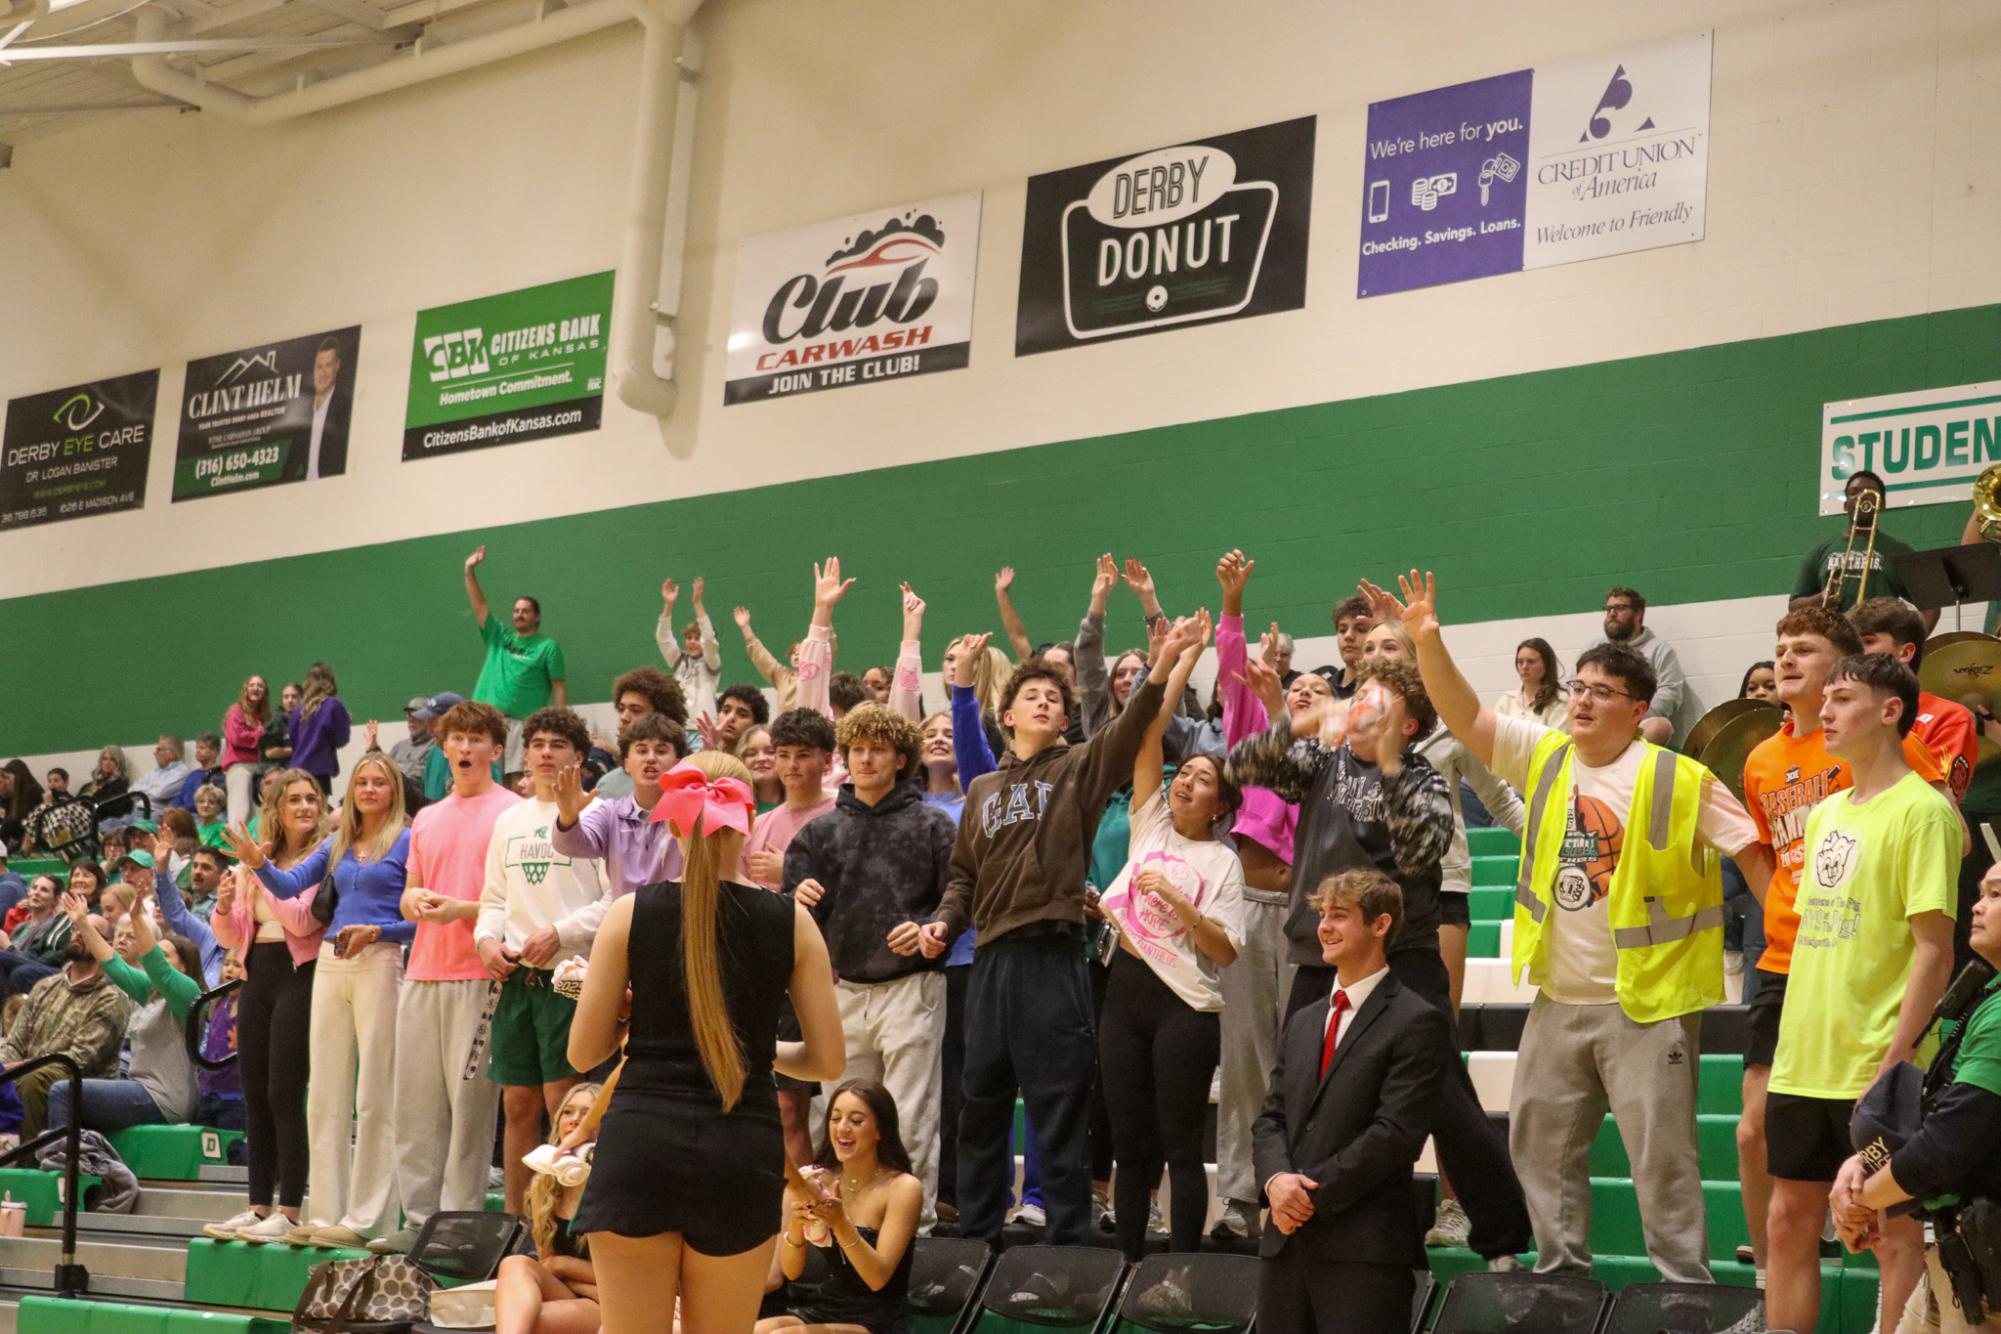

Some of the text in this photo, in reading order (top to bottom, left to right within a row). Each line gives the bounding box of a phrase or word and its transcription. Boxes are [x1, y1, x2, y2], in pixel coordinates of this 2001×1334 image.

[1370, 117, 1523, 160] We're here for you.
[1537, 136, 1696, 185] CREDIT UNION
[1113, 155, 1209, 219] DERBY
[1572, 168, 1658, 201] of America
[1362, 218, 1521, 256] Checking. Savings. Loans.
[1537, 201, 1693, 245] Welcome to Friendly
[1098, 214, 1240, 287] DONUT
[762, 256, 939, 345] Club
[490, 314, 600, 356] CITIZENS BANK
[499, 339, 599, 366] OF KANSAS
[756, 325, 933, 372] CARWASH
[439, 385, 496, 406] Hometown
[499, 370, 573, 396] Commitment.
[768, 354, 921, 395] JOIN THE CLUB!
[188, 373, 302, 419] CLINT HELM
[7, 424, 145, 467] DERBY EYE CARE
[424, 409, 582, 448] CitizensBankofKansas.com
[1831, 415, 2001, 481] STUDEN
[41, 465, 73, 480] LOGAN
[73, 456, 118, 475] BANISTER
[195, 446, 279, 480] (316) 650-4323
[210, 470, 260, 488] ClintHelm.com
[1860, 1136, 1889, 1165] RBY
